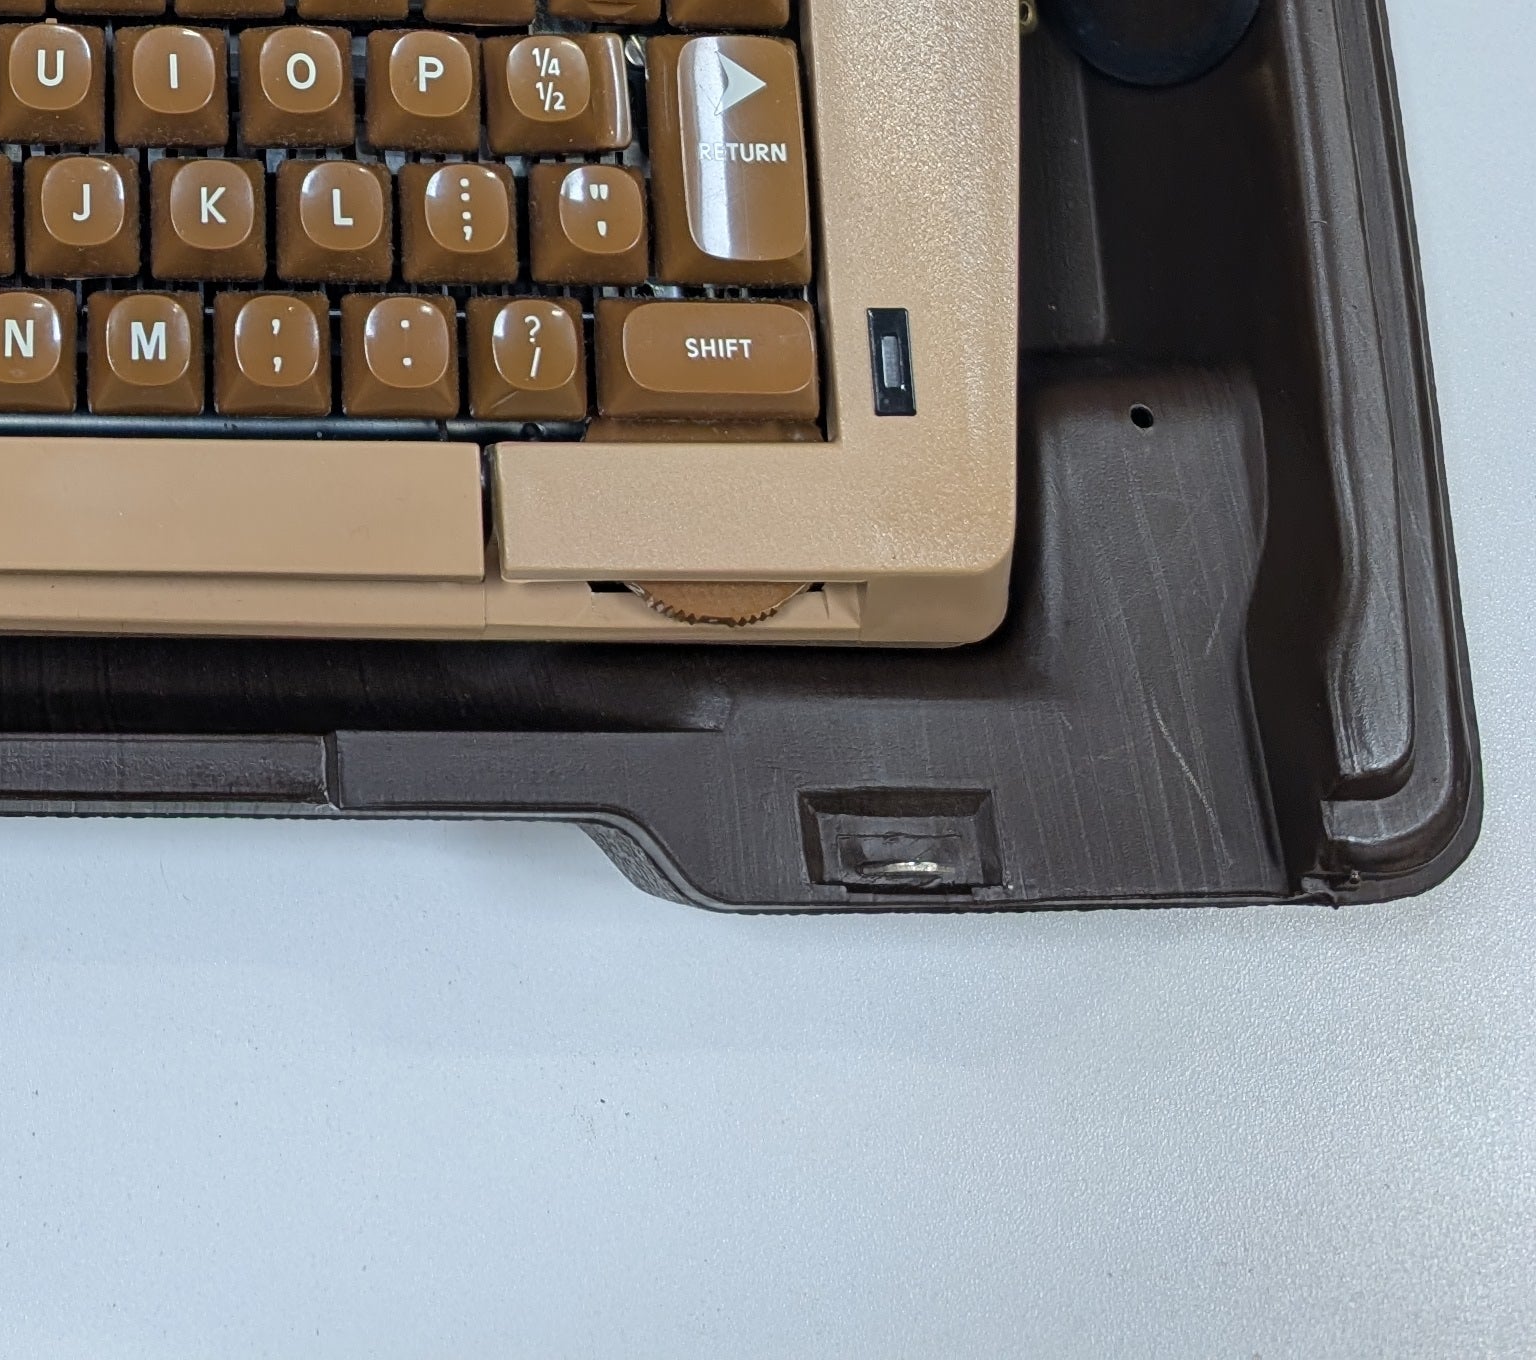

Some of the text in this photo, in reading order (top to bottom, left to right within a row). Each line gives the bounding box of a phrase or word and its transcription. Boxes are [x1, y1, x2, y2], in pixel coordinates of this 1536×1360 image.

[37, 50, 64, 87] U
[169, 53, 178, 89] I
[286, 53, 316, 90] O
[418, 56, 444, 92] P
[699, 143, 787, 163] RETURN
[72, 183, 91, 221] J
[200, 186, 227, 224] K
[332, 188, 353, 226] L
[3, 320, 34, 358] N
[130, 321, 167, 360] M
[524, 315, 541, 343] ?
[529, 347, 542, 379] /
[685, 338, 753, 359] SHIFT
